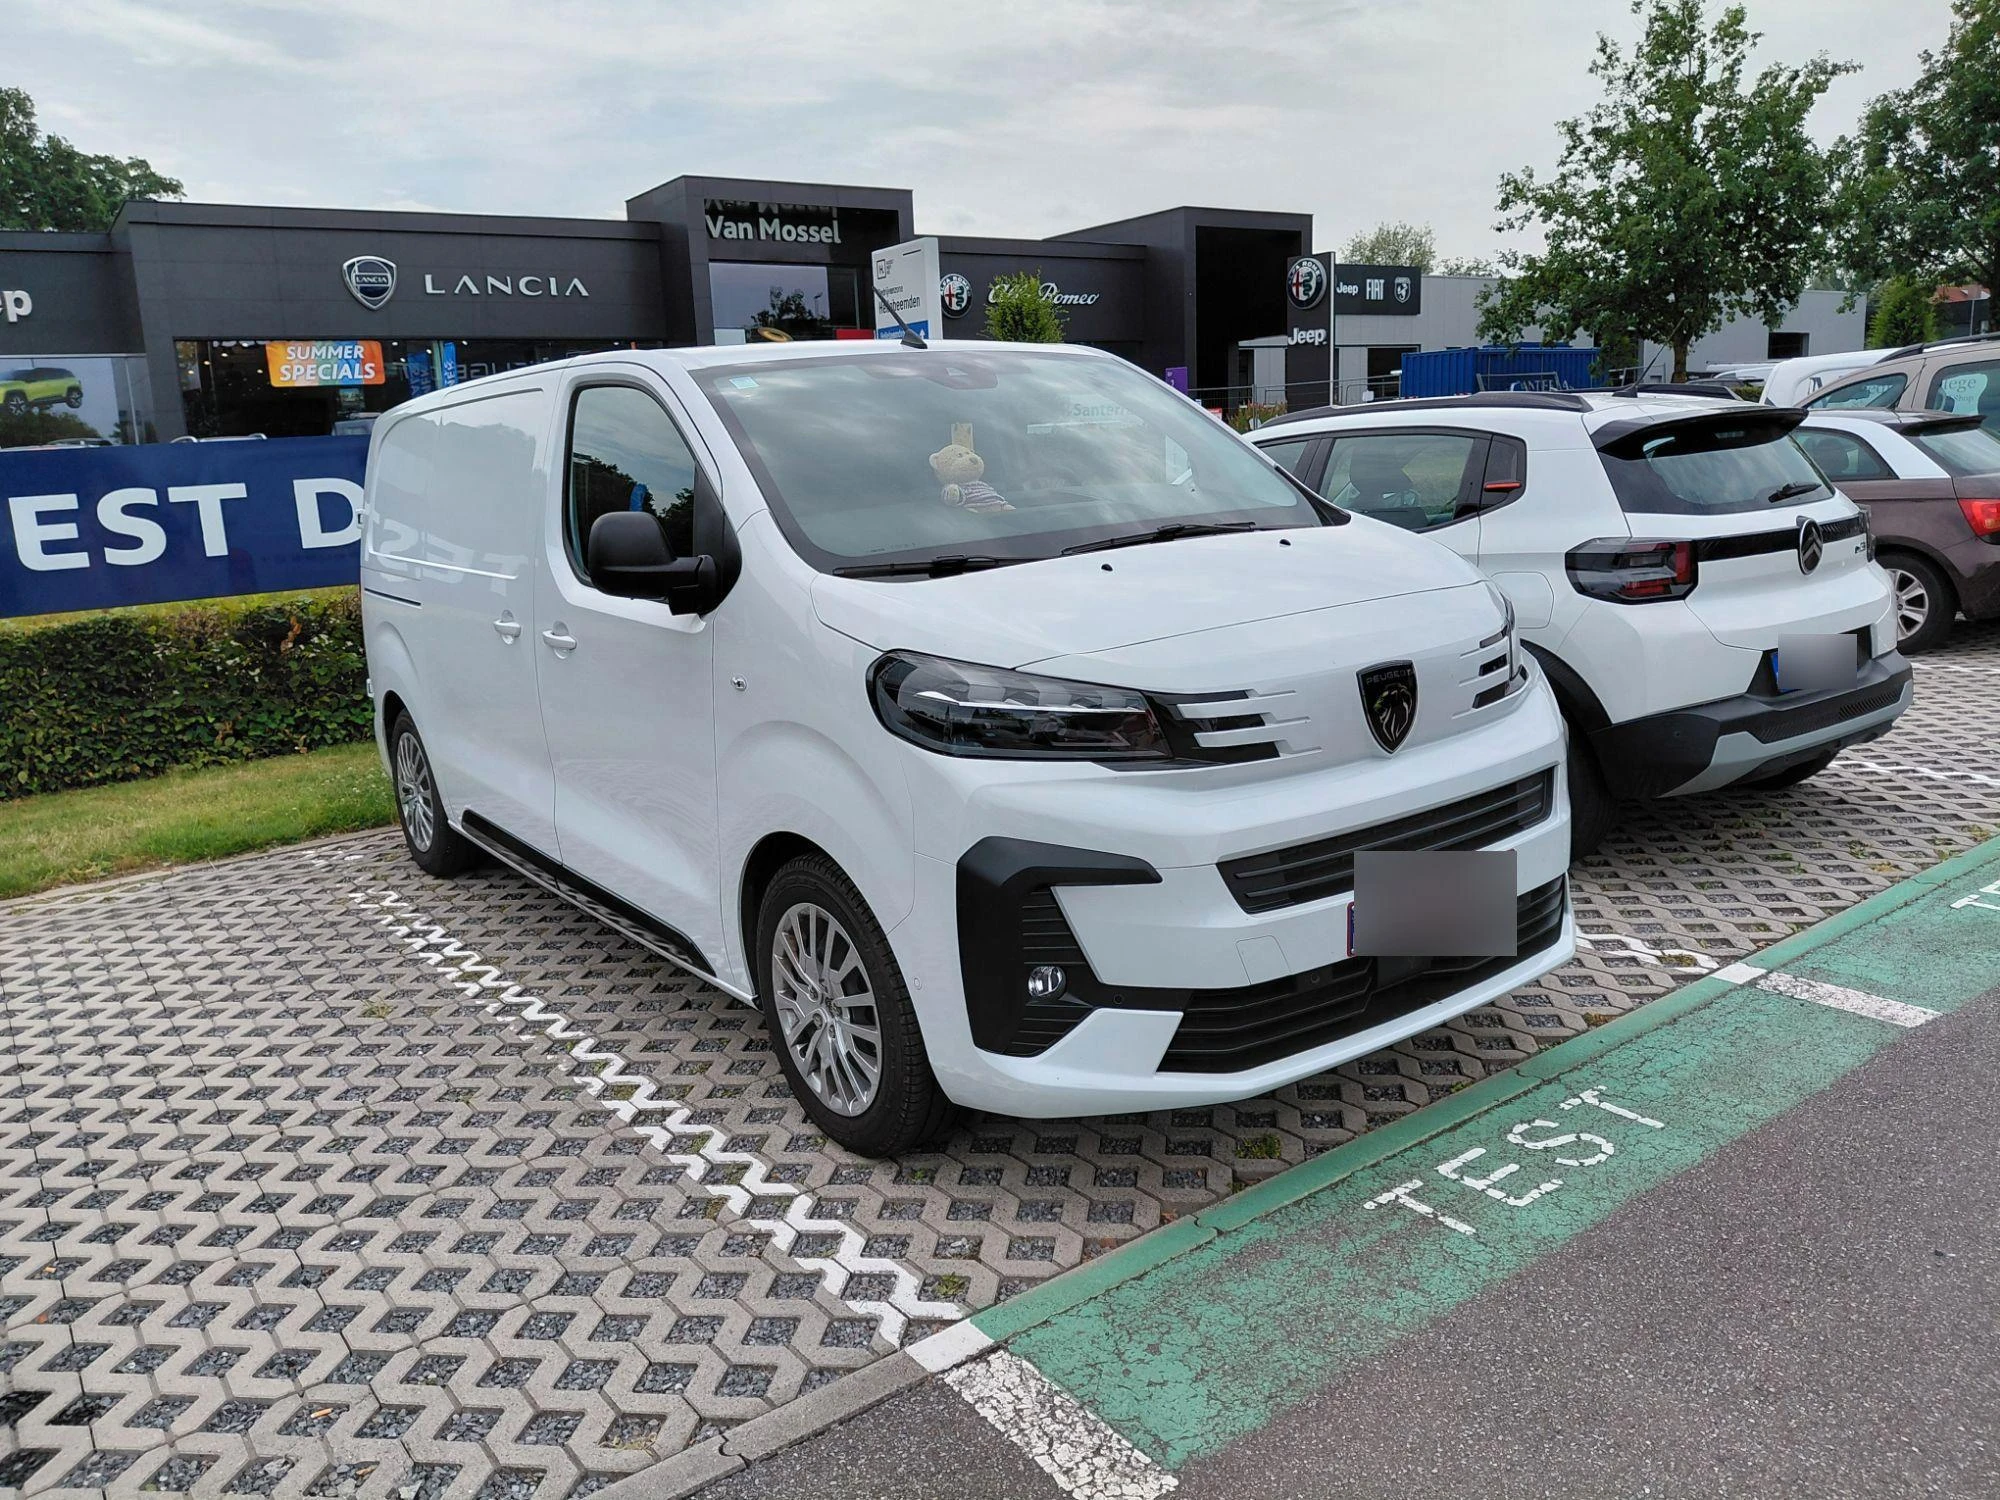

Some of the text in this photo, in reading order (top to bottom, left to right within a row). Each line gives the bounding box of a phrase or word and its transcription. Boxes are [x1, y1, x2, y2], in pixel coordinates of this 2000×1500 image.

[704, 214, 841, 244] Van Mossel
[356, 276, 387, 284] LANCIA
[424, 274, 590, 297] LANCIA
[1336, 282, 1358, 295] Jeep
[1366, 279, 1384, 300] FIAT
[1038, 282, 1099, 305] Romeo
[286, 345, 364, 361] SUMMER
[279, 362, 376, 382] SPECIALS
[8, 482, 247, 572] EST
[1366, 668, 1412, 685] PEUGEOT
[1363, 1086, 1665, 1235] TEST
